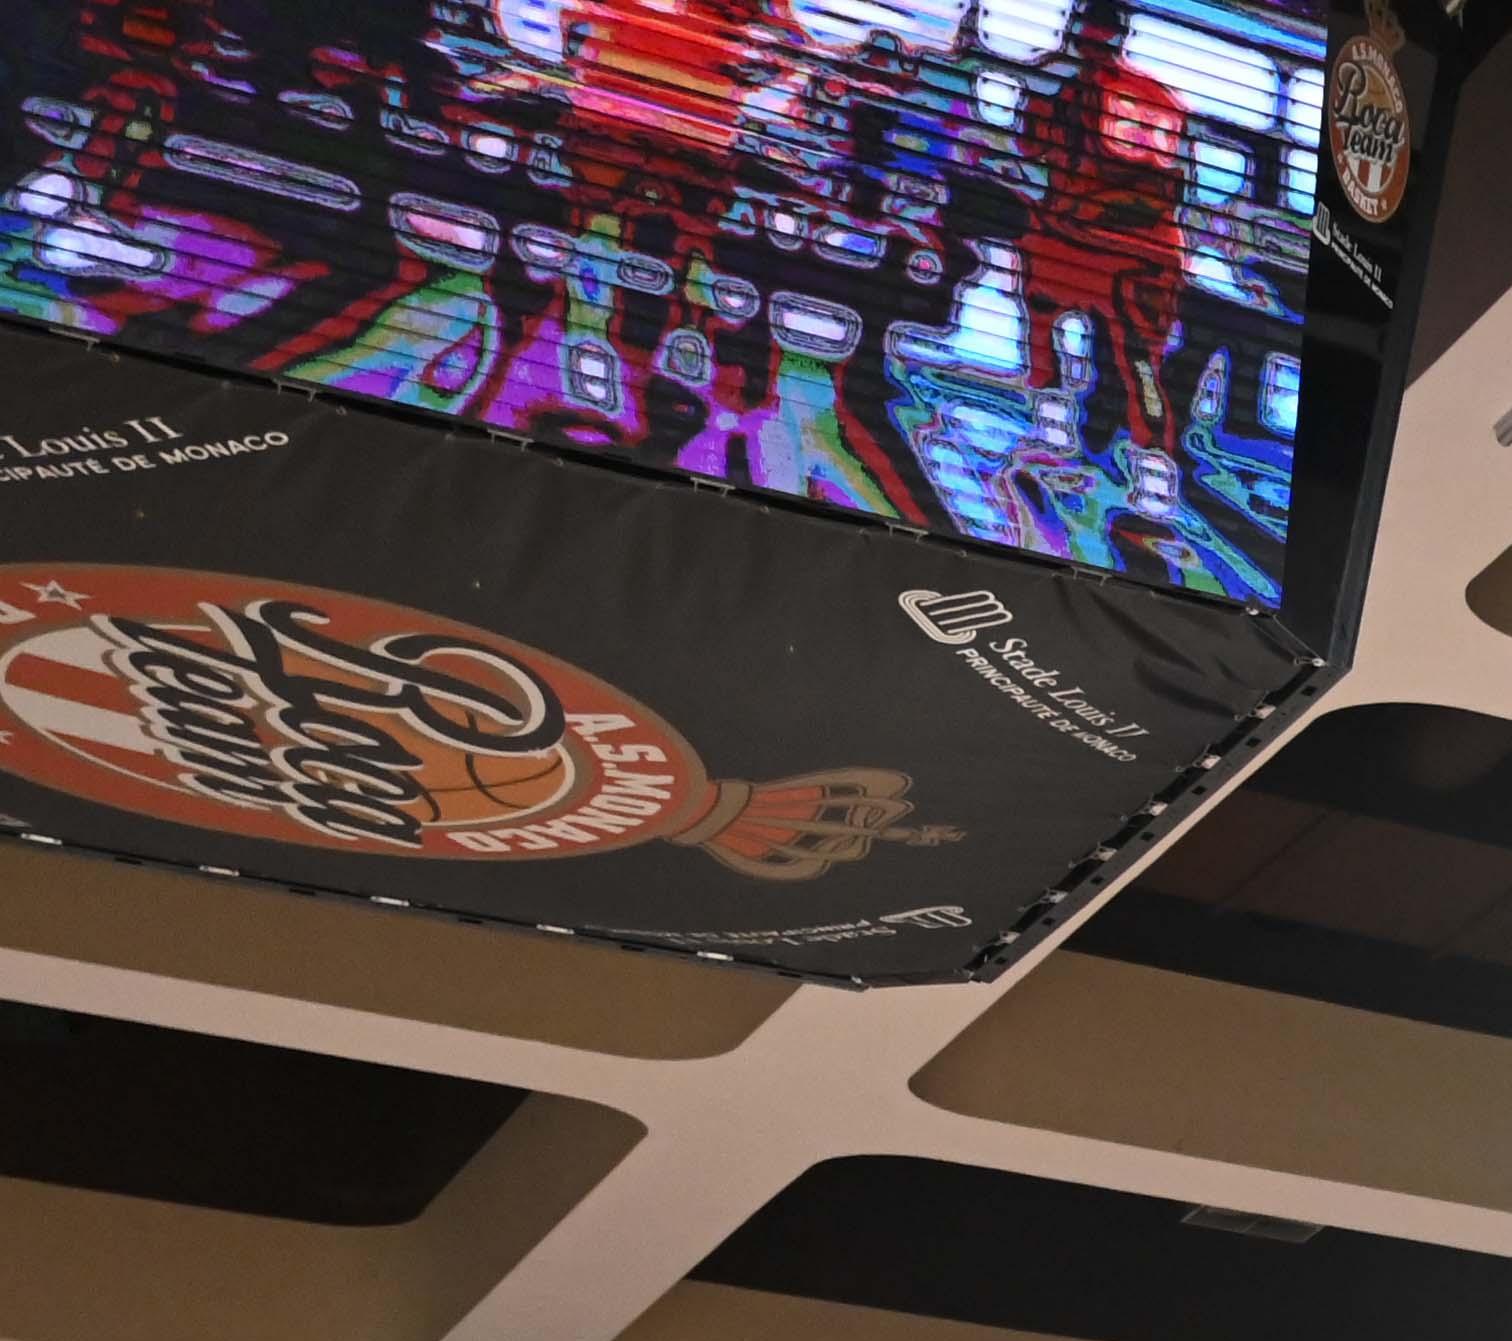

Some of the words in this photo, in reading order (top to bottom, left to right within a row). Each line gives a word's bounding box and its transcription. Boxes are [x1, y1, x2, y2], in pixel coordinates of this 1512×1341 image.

[1, 426, 129, 459] Louis
[124, 416, 184, 443] II
[112, 454, 156, 471] DE
[159, 432, 289, 465] MONACO
[989, 638, 1060, 688] Stade
[1048, 686, 1114, 727] Louis
[1050, 717, 1080, 733] DE
